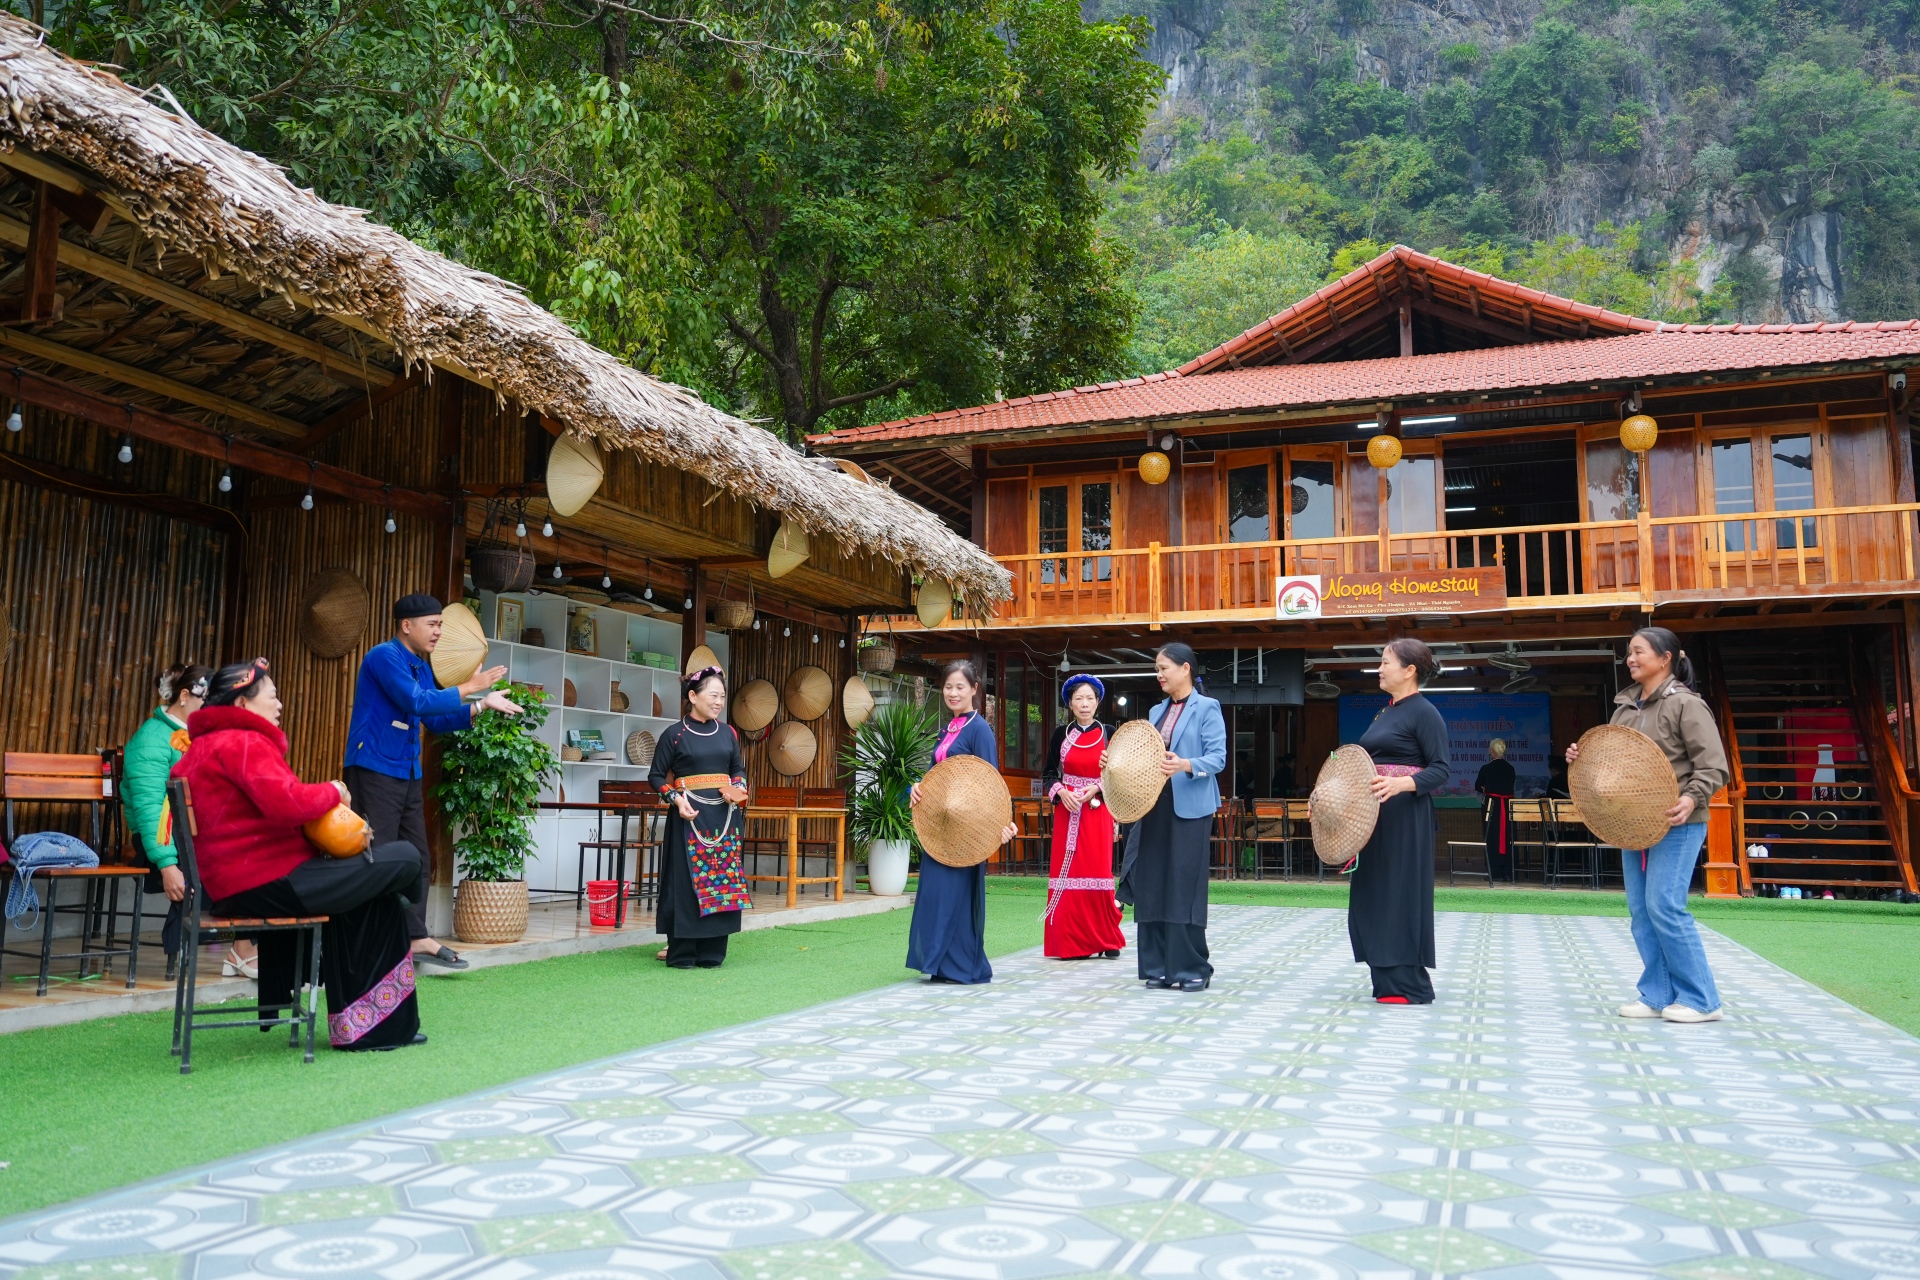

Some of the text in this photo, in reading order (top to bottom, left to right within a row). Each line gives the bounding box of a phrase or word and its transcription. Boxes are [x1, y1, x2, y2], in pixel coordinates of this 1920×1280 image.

[1320, 576, 1479, 601] Noọng Homestay
[1449, 716, 1514, 731] TRÌNH DIỄN
[1454, 740, 1464, 750] TRỊ
[1465, 739, 1478, 749] VĂN
[1518, 752, 1544, 761] NGUYÊN
